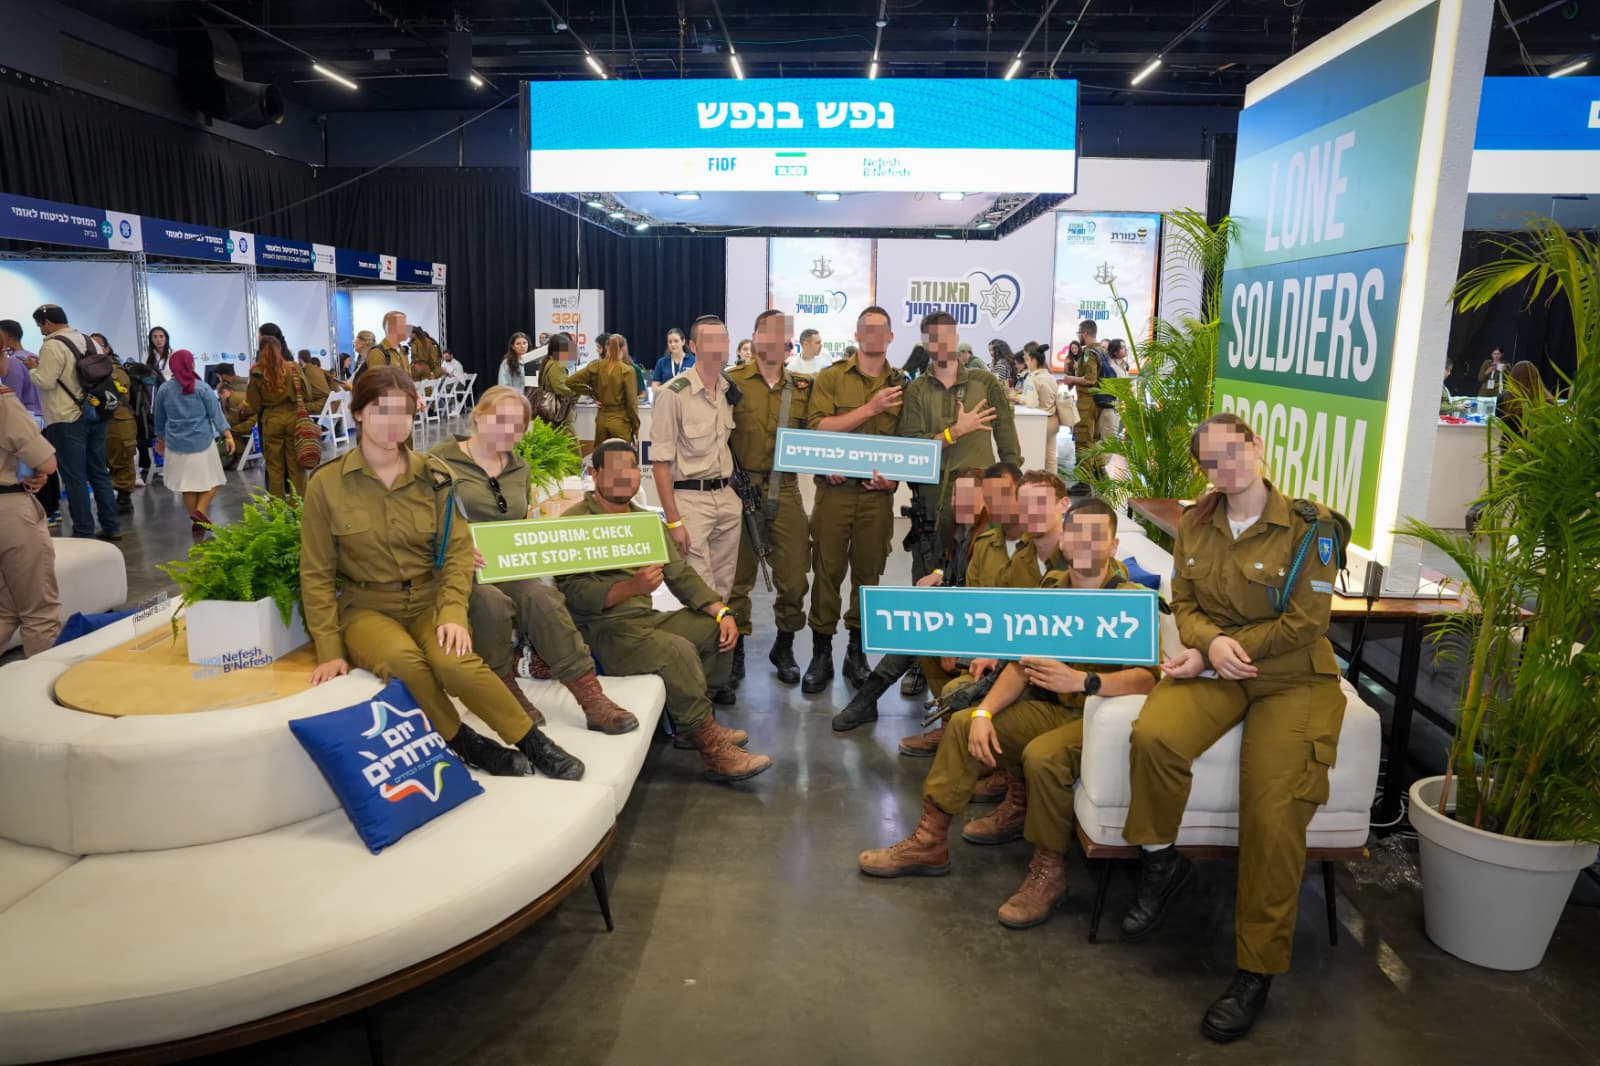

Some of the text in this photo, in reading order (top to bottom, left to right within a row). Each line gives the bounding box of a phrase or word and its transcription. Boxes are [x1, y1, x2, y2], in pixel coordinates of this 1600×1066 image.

[697, 101, 895, 129] נפש בנפש
[708, 157, 736, 172] FIDF
[863, 157, 901, 169] Nefesh
[1264, 131, 1356, 253] LONE
[11, 206, 97, 227] המוסד לביטוח לאומי
[1111, 232, 1136, 241] כוורת
[911, 281, 970, 303] האגודה
[552, 313, 581, 324] 320
[1228, 268, 1384, 382] SOLDIERS
[786, 444, 929, 465] יום סידורים לבודדים
[1222, 394, 1367, 529] OGRAM
[514, 525, 632, 546] SIDDURIM: CHECK
[498, 542, 651, 569] NEXT STOP: THE BEACH
[876, 609, 1140, 641] לא יאומן כי יסודר
[222, 646, 262, 663] Nefesh
[223, 654, 273, 673] B'Nefesh
[381, 720, 415, 748] יום
[361, 732, 447, 788] סידורים
